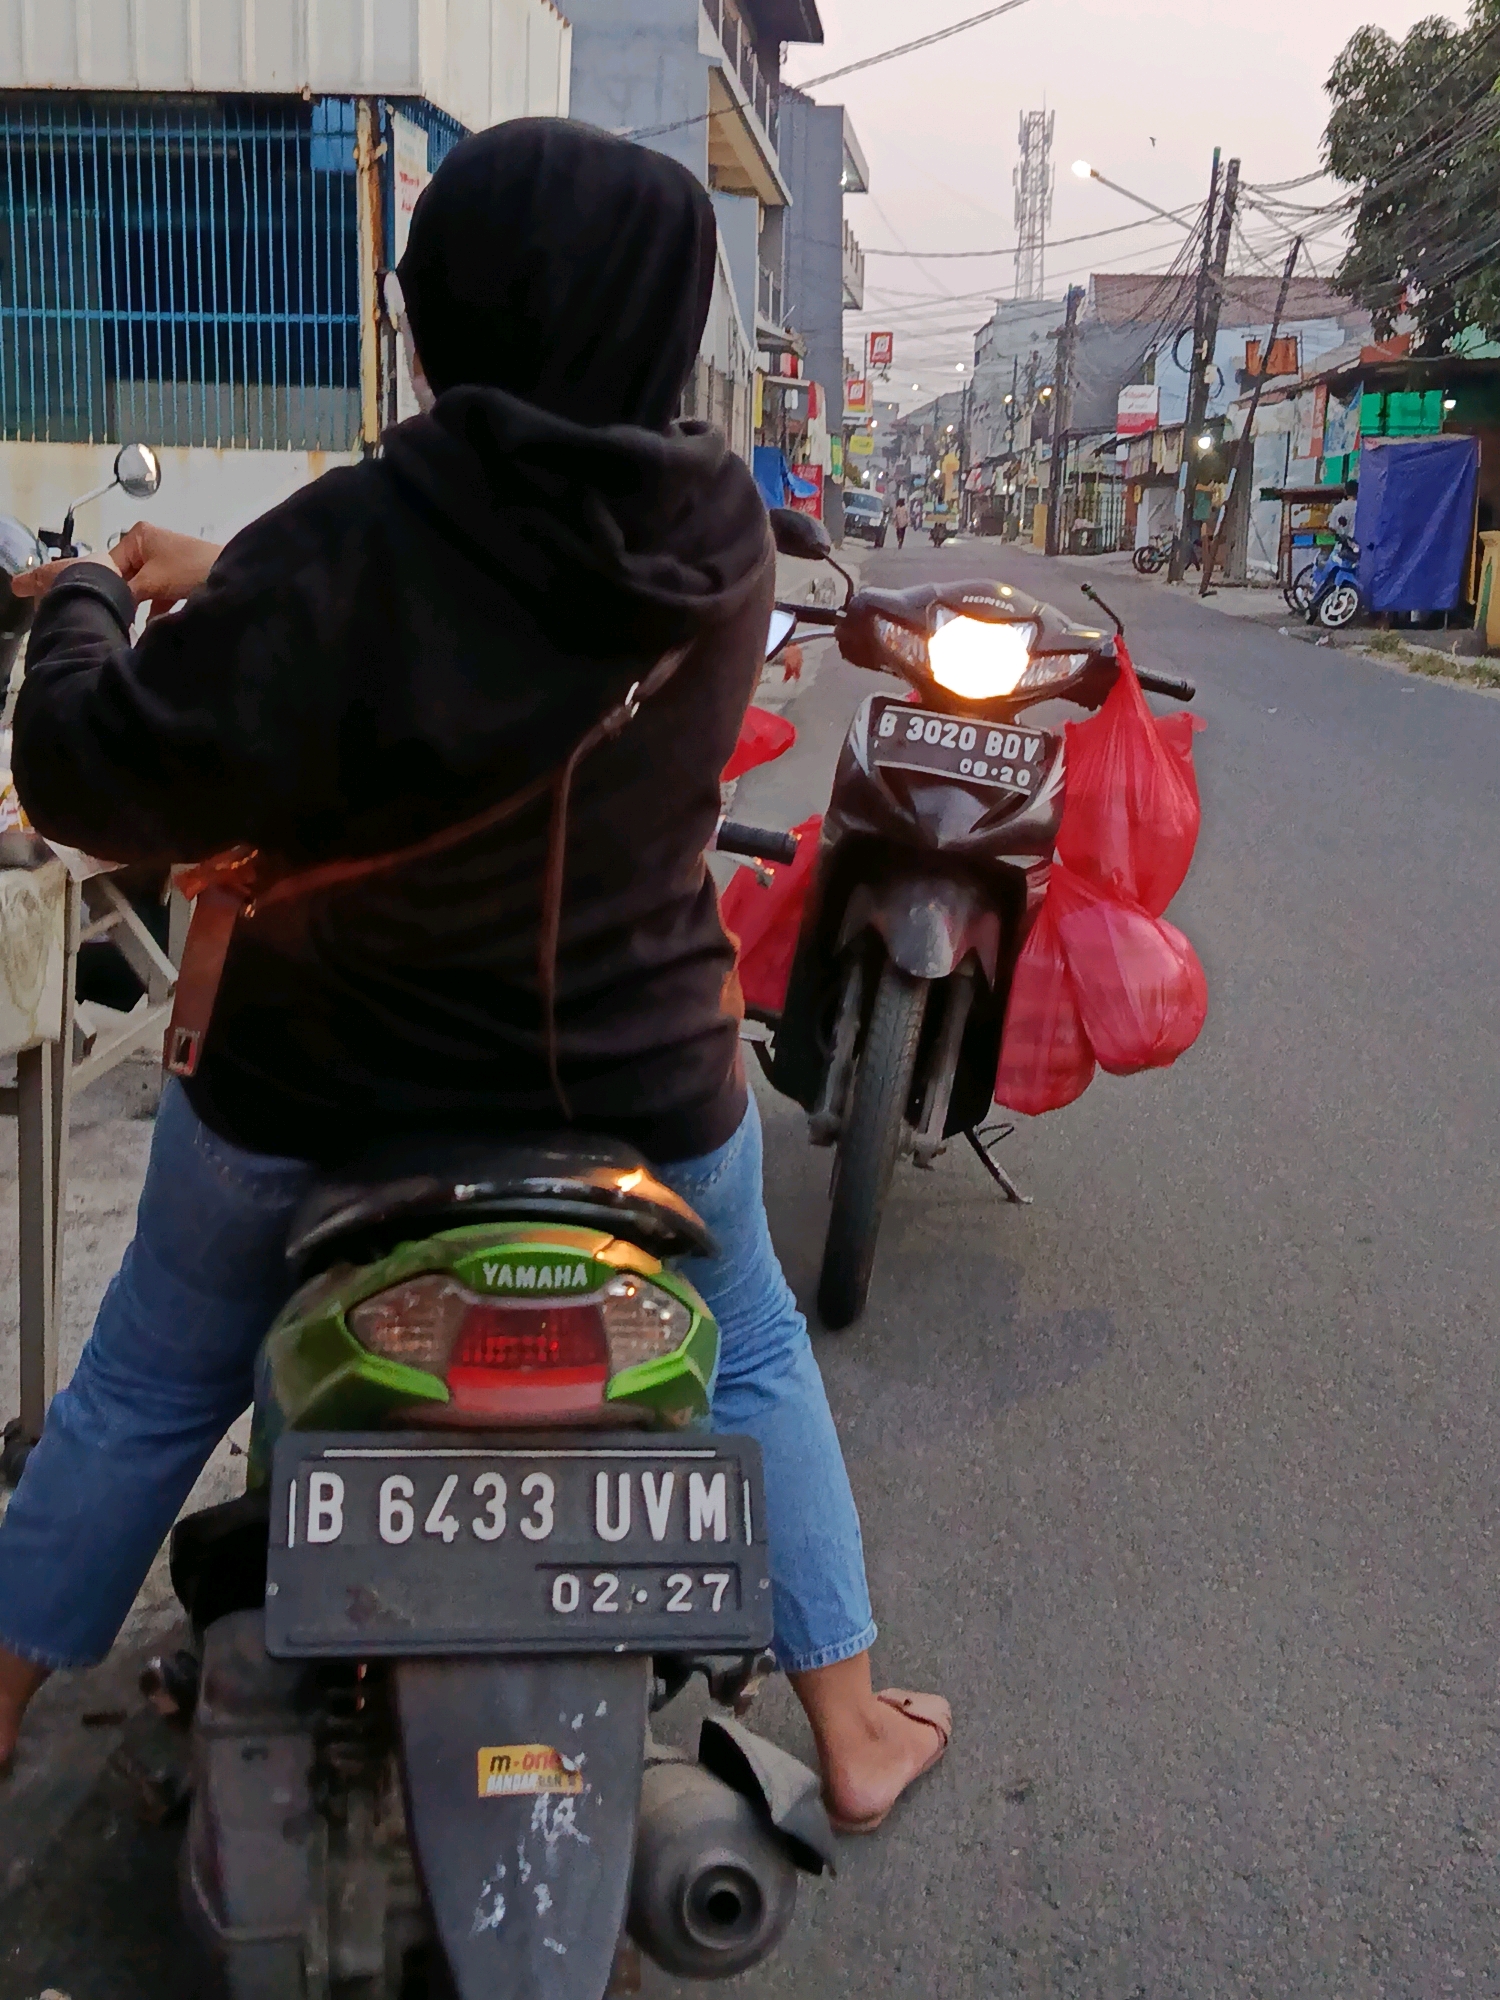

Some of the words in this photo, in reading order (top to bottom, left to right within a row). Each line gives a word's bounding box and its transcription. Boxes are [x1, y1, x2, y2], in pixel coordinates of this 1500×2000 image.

[962, 595, 1015, 613] HONDA
[878, 712, 898, 737] B
[906, 716, 977, 750] 3020
[984, 730, 1040, 762] BDV
[482, 1262, 588, 1289] YAMAHA
[307, 1472, 345, 1543] B
[378, 1471, 556, 1544] 6433
[595, 1471, 727, 1543] UVM
